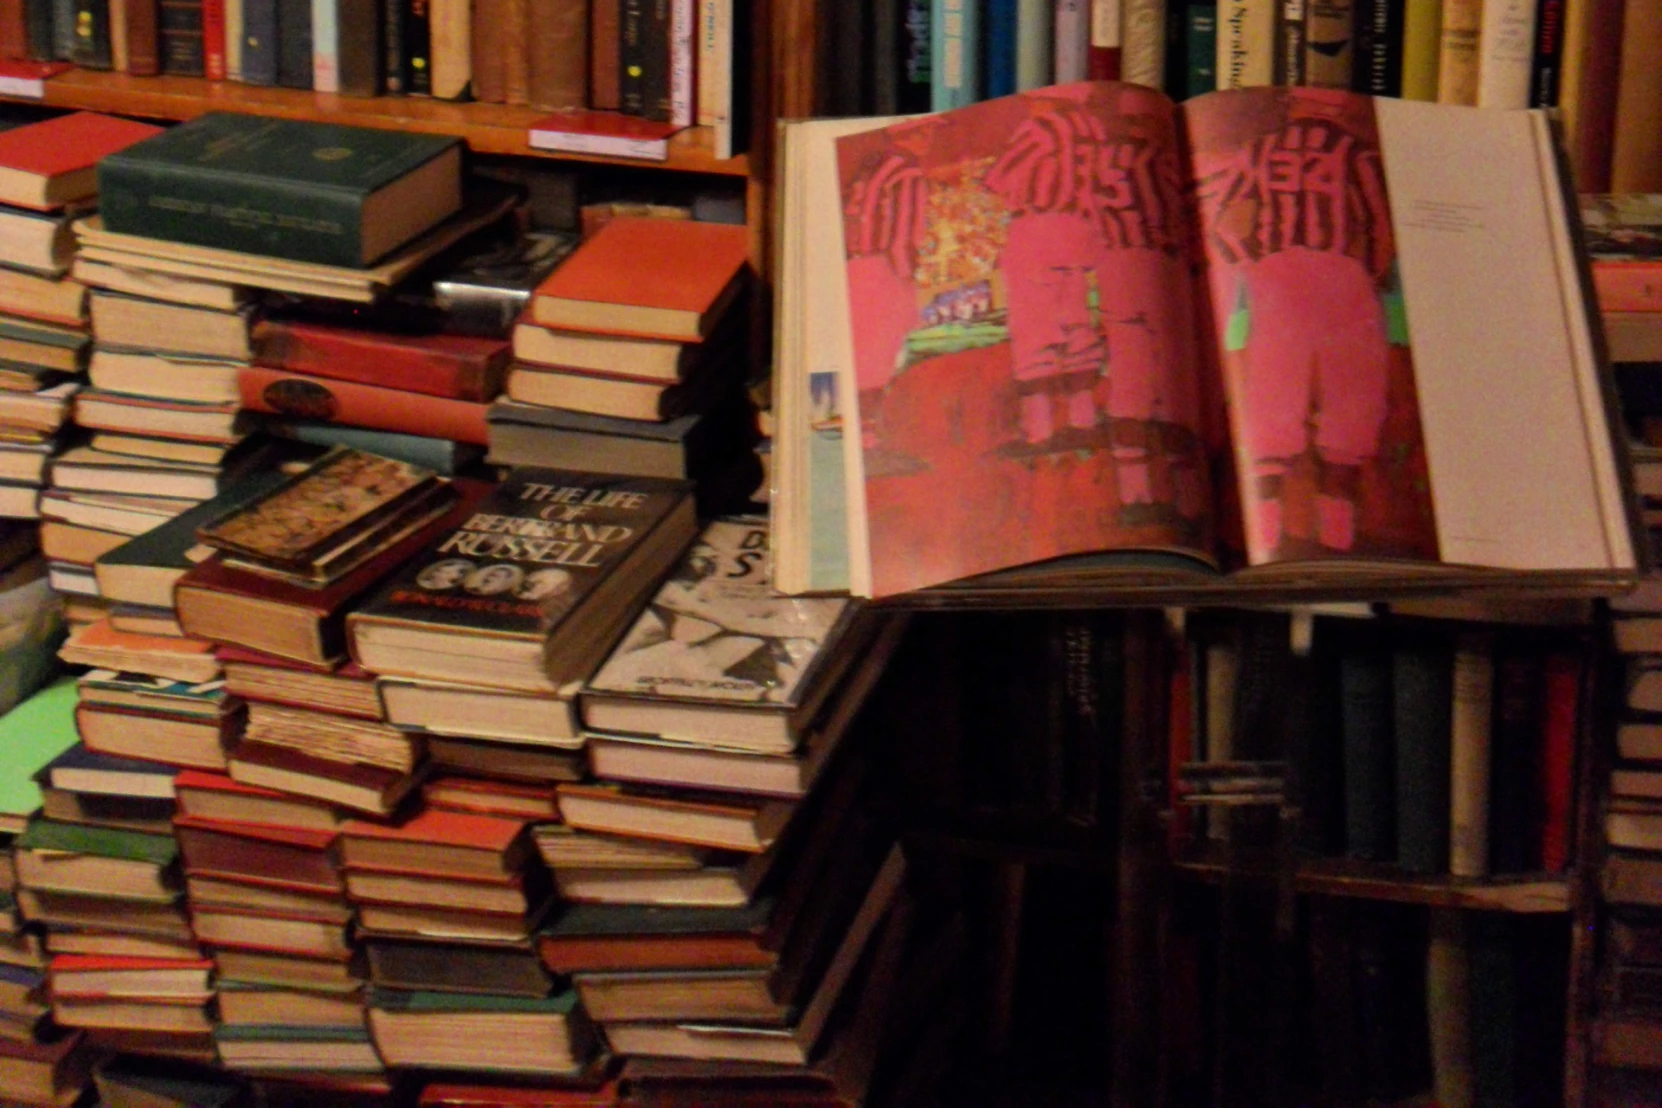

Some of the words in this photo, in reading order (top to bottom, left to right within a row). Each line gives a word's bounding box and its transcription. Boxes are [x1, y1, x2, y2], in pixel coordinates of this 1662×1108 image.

[1228, 4, 1249, 89] Speaking
[520, 482, 583, 504] THE
[585, 490, 648, 509] LIFE
[540, 503, 592, 522] OF
[461, 513, 634, 544] BERTRAND
[437, 530, 604, 568] RUSSELL
